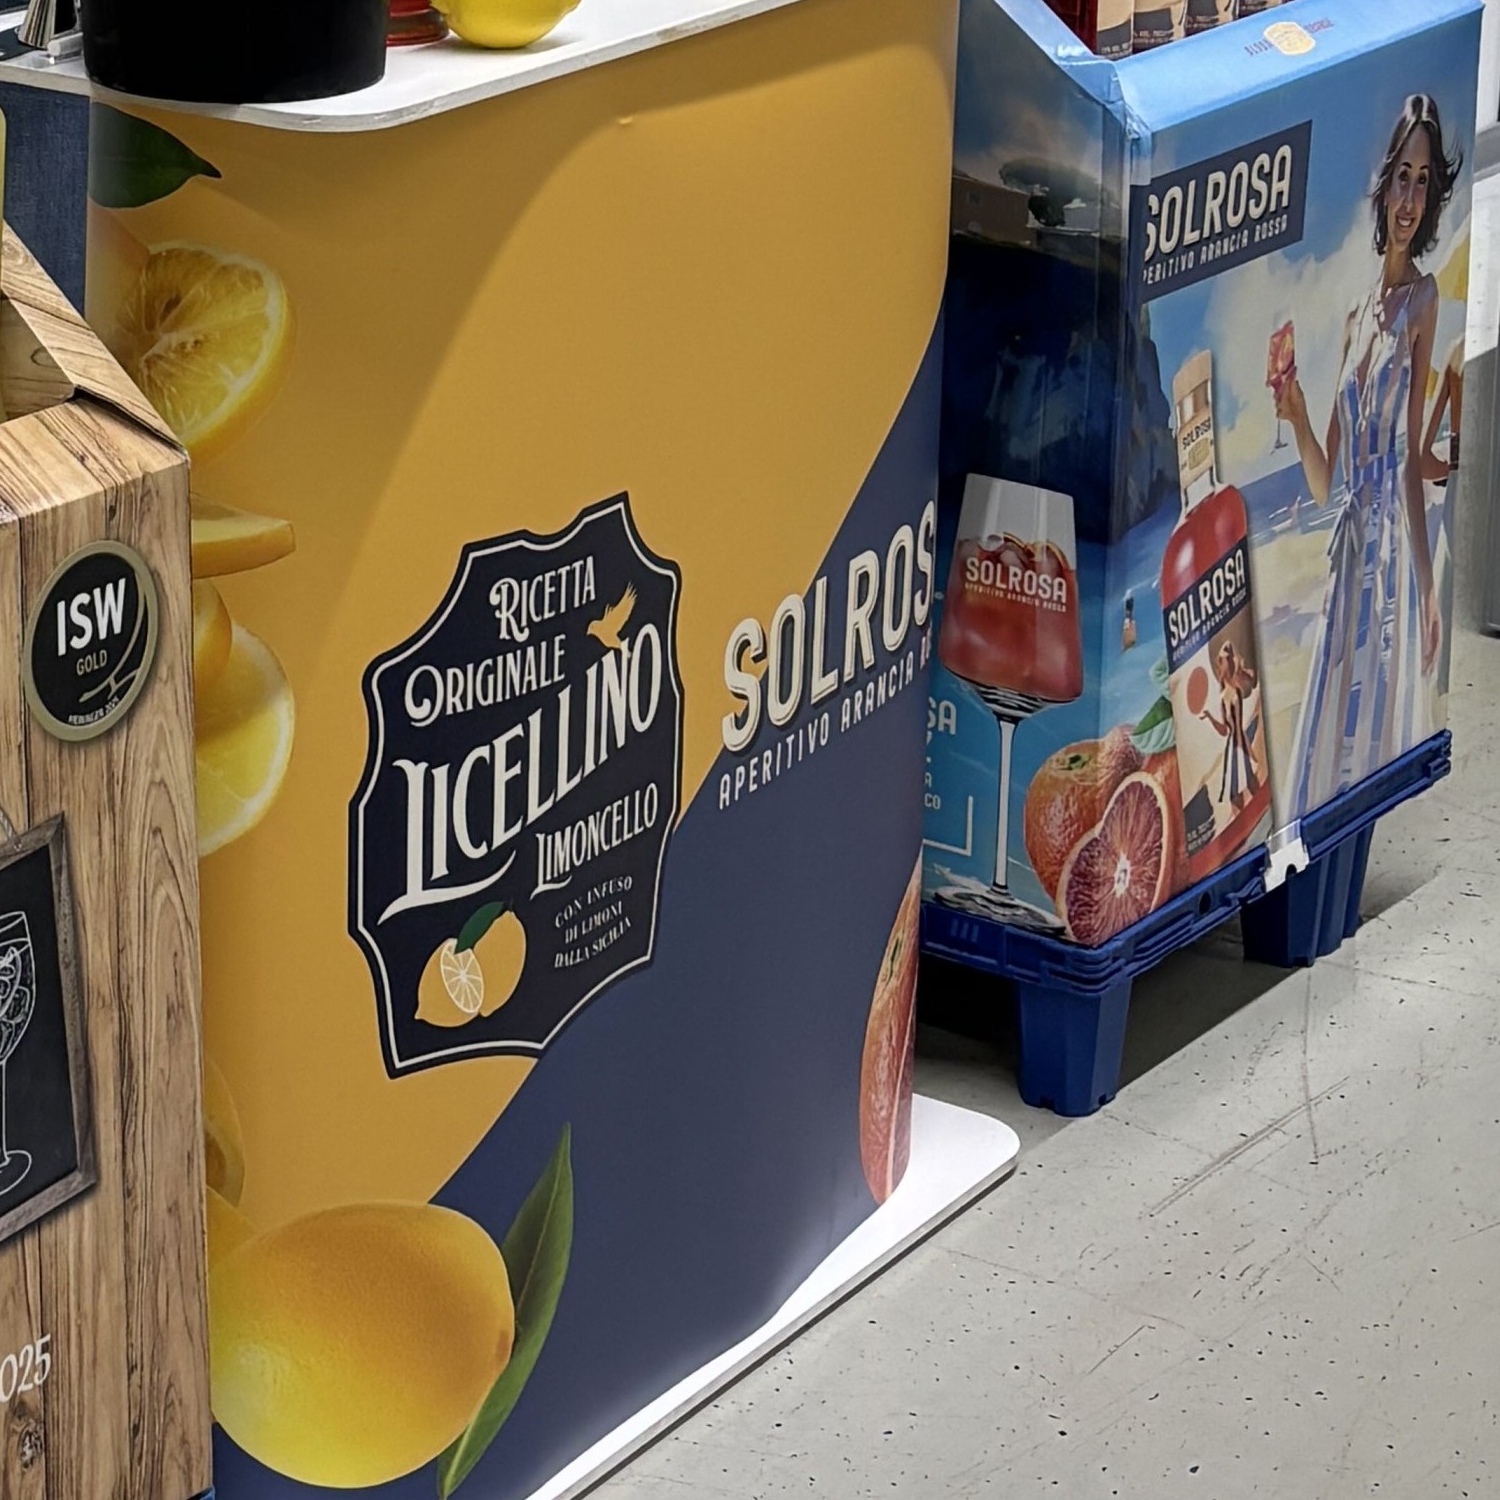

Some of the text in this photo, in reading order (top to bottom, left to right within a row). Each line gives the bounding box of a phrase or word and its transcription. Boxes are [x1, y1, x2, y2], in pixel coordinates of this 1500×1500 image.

[1200, 229, 1249, 265] ARANCIA
[1254, 214, 1288, 243] ROSSA
[56, 577, 127, 657] ISW
[488, 554, 596, 643] RICETTA
[965, 557, 1067, 604] SOLROSA
[1168, 548, 1246, 648] SOLROSA
[76, 649, 108, 676] GOLD
[721, 500, 936, 752] SOLROS
[403, 633, 567, 728] ORIGINALE
[719, 711, 830, 810] APERITIVO
[840, 651, 914, 733] ARANCIA
[377, 622, 662, 926] LICELLINO
[530, 781, 659, 901] LIMONCELLO
[554, 874, 634, 929] CON INFUSO
[554, 916, 632, 968] DALLA SICILIA
[564, 900, 623, 944] DI LIMONI
